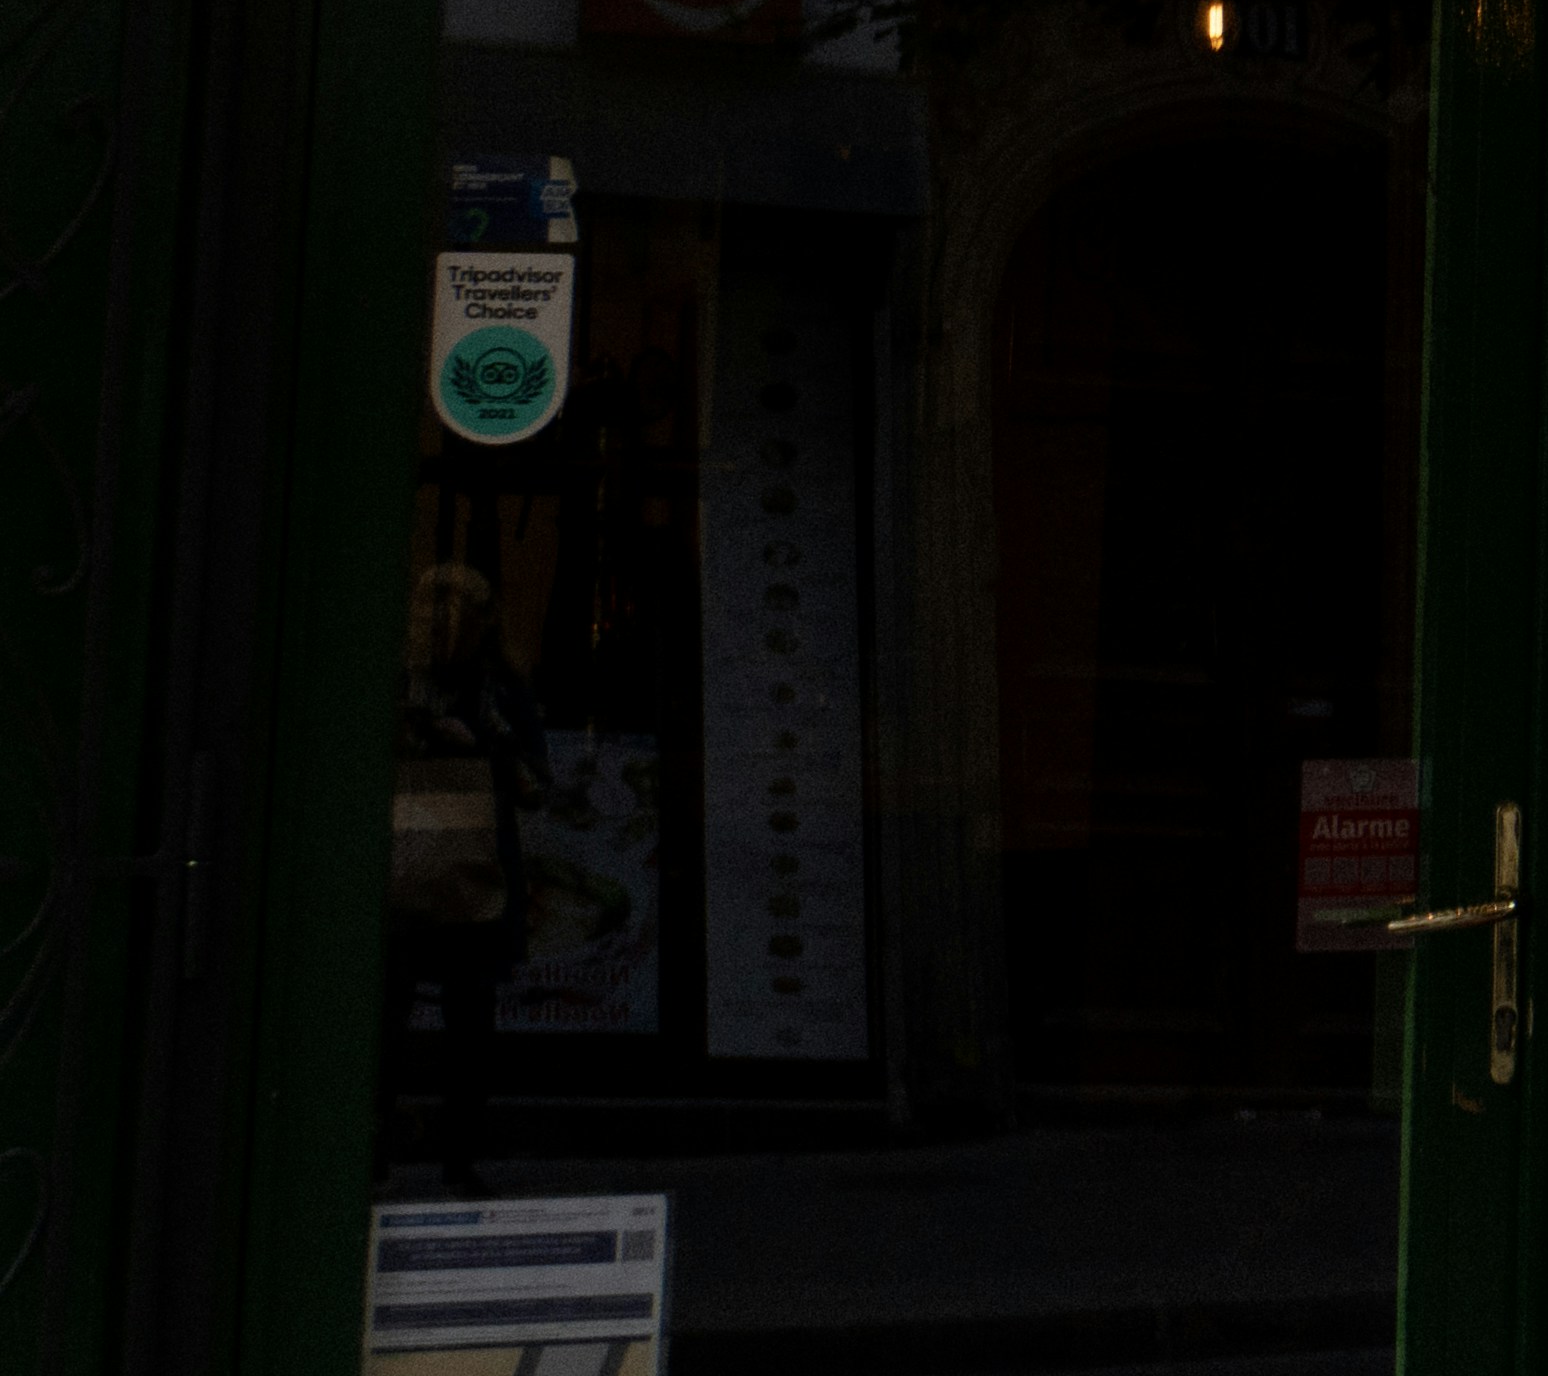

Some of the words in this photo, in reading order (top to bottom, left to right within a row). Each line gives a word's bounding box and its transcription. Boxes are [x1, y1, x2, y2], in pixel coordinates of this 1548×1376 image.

[448, 265, 563, 284] Tripadvisor
[465, 302, 538, 320] Choice
[1311, 814, 1411, 840] Alarme
